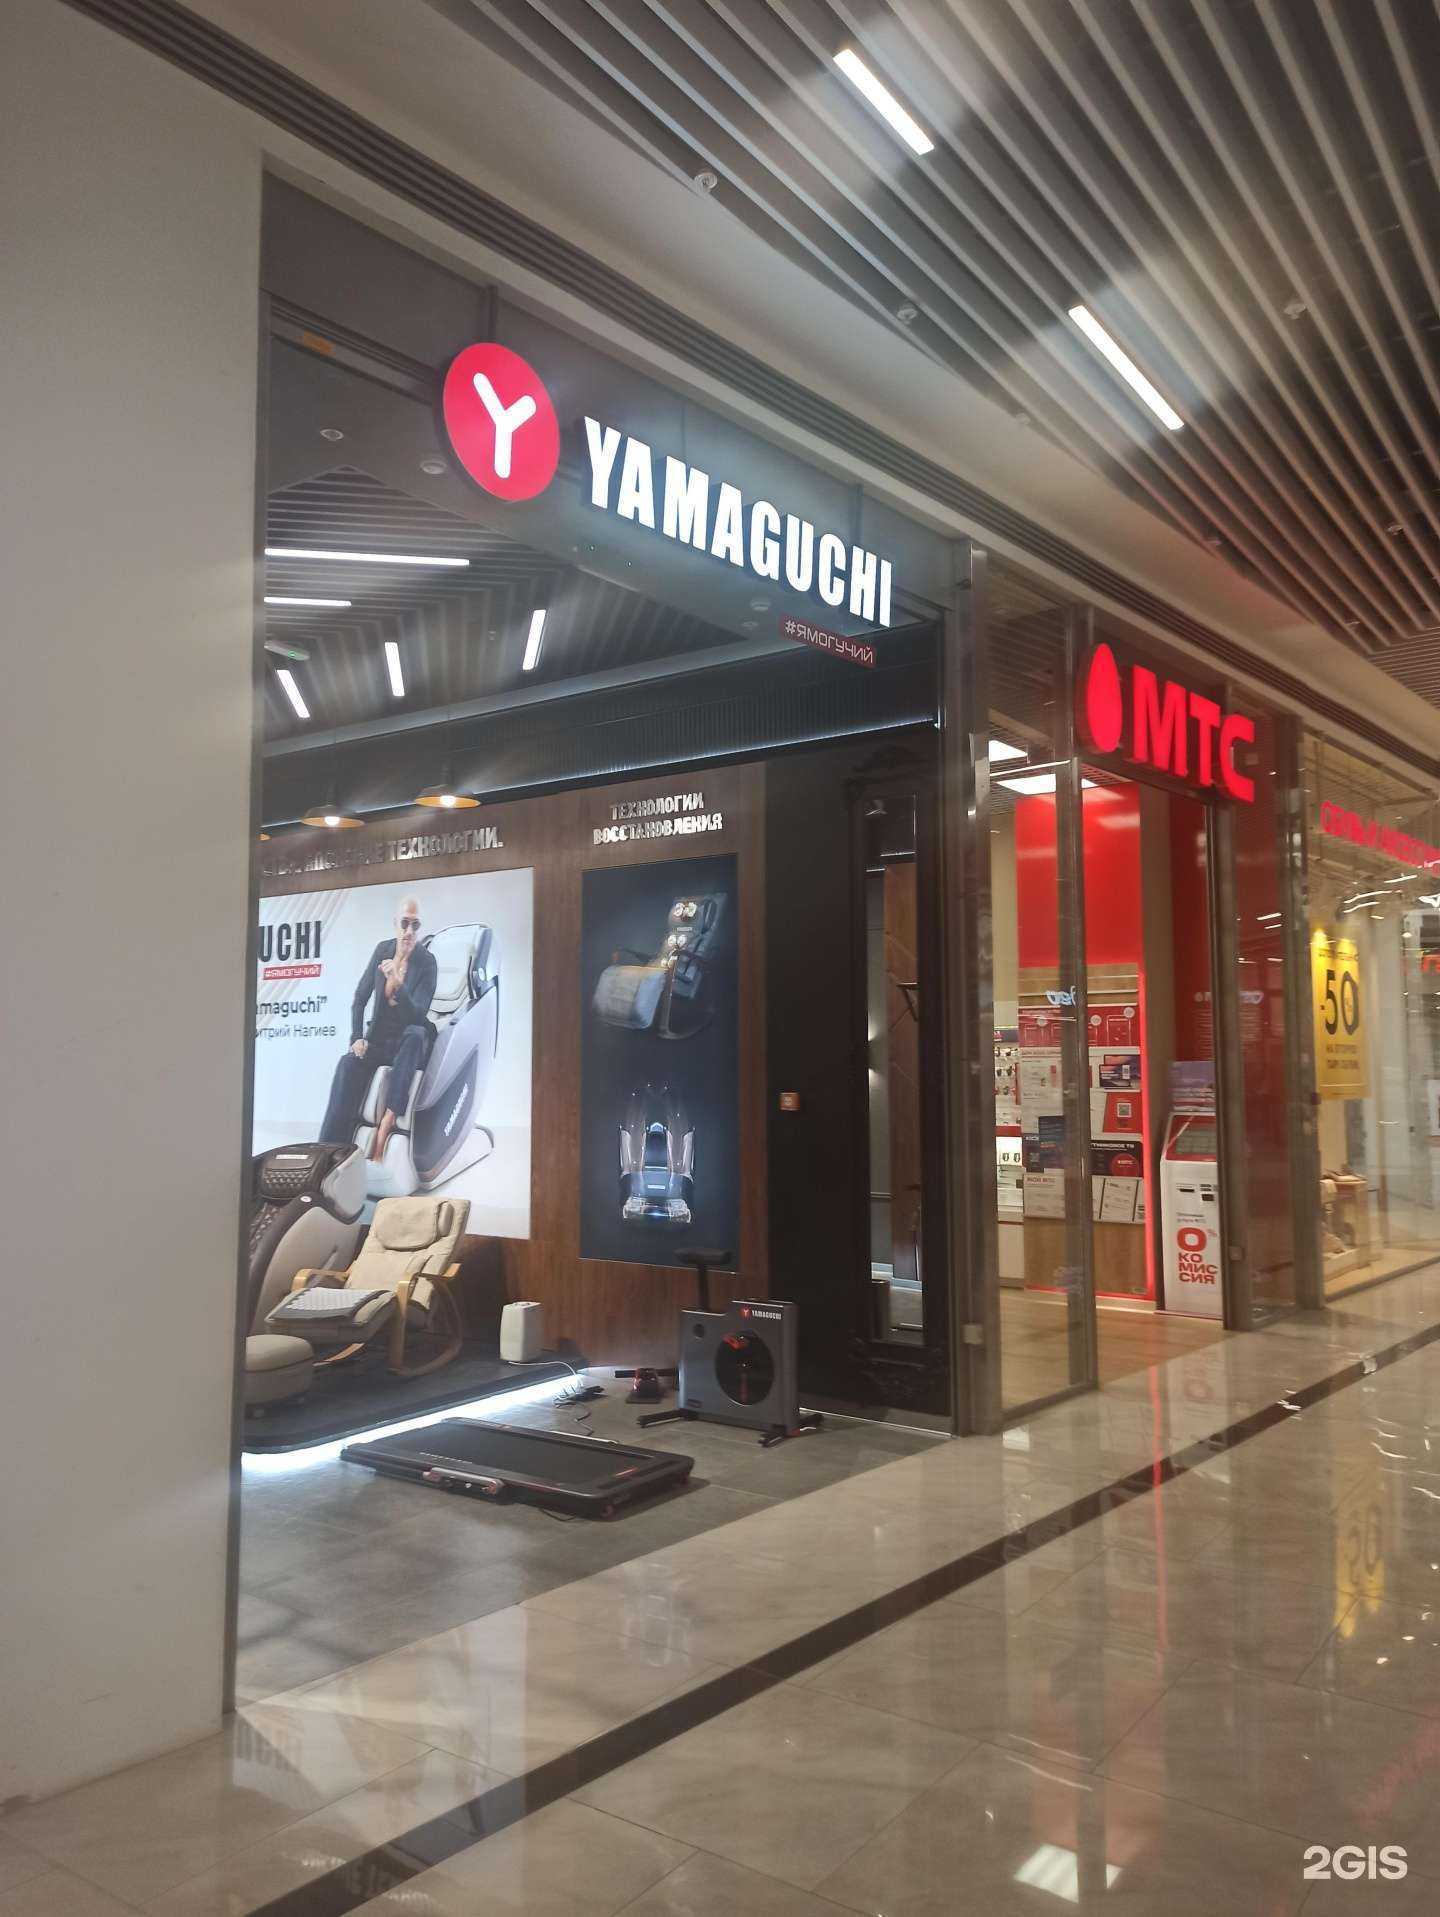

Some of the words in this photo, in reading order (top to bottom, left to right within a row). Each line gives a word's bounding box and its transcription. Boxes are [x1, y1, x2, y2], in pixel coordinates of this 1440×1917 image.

[584, 415, 894, 628] YAMAGUCHI
[785, 619, 873, 664] #ЯМОГУЧИЙ
[1132, 665, 1255, 803] МТС
[609, 792, 704, 820] ТЕХНОЛОГИИ
[593, 812, 723, 845] ВОССТАНОВЛЕНИЯ
[293, 1024, 337, 1038] Нагиев
[751, 1309, 782, 1320] YAMAGUCHI
